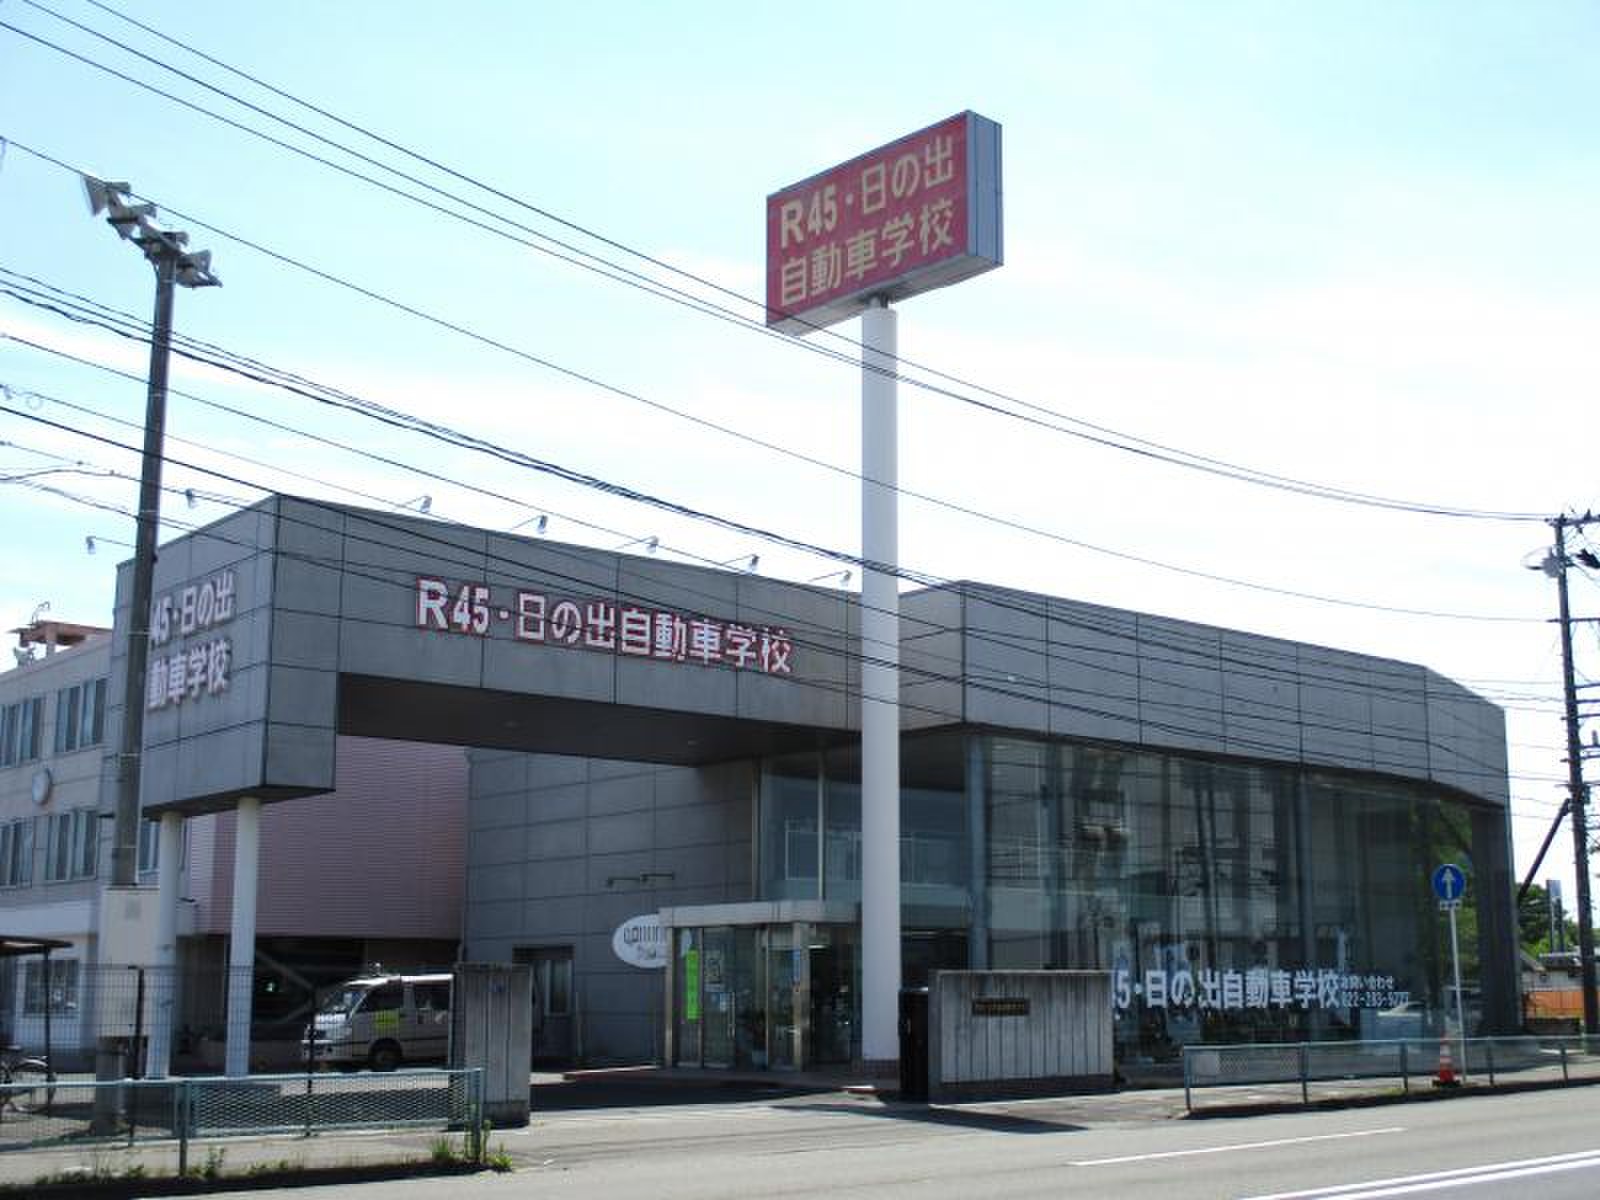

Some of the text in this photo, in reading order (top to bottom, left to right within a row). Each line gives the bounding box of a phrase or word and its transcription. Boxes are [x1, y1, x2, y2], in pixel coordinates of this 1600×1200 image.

[781, 198, 954, 306] 自動車学校
